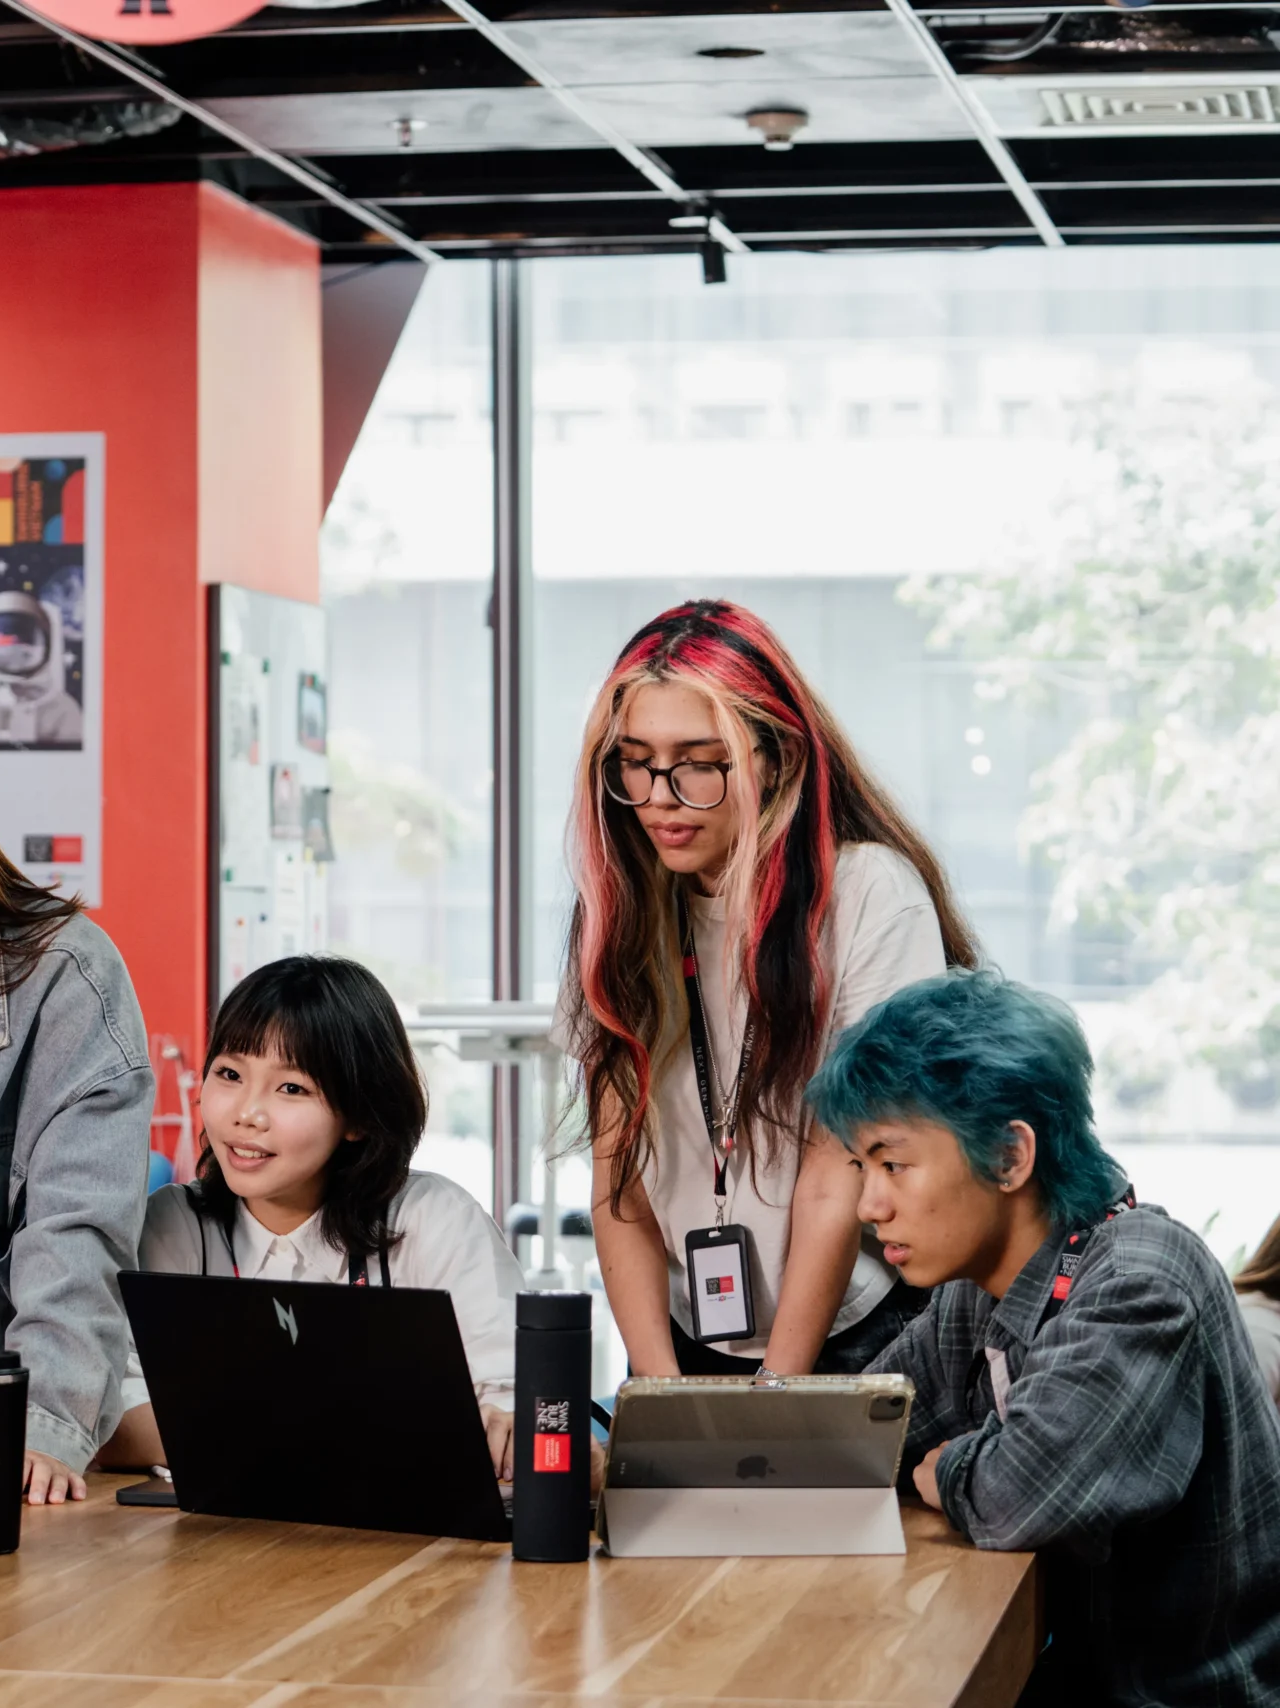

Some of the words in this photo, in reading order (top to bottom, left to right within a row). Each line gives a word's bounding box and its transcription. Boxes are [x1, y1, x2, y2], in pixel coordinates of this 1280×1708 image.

[696, 1046, 705, 1073] NEXT
[700, 1080, 709, 1101] GEN
[557, 1400, 569, 1433] SWIN
